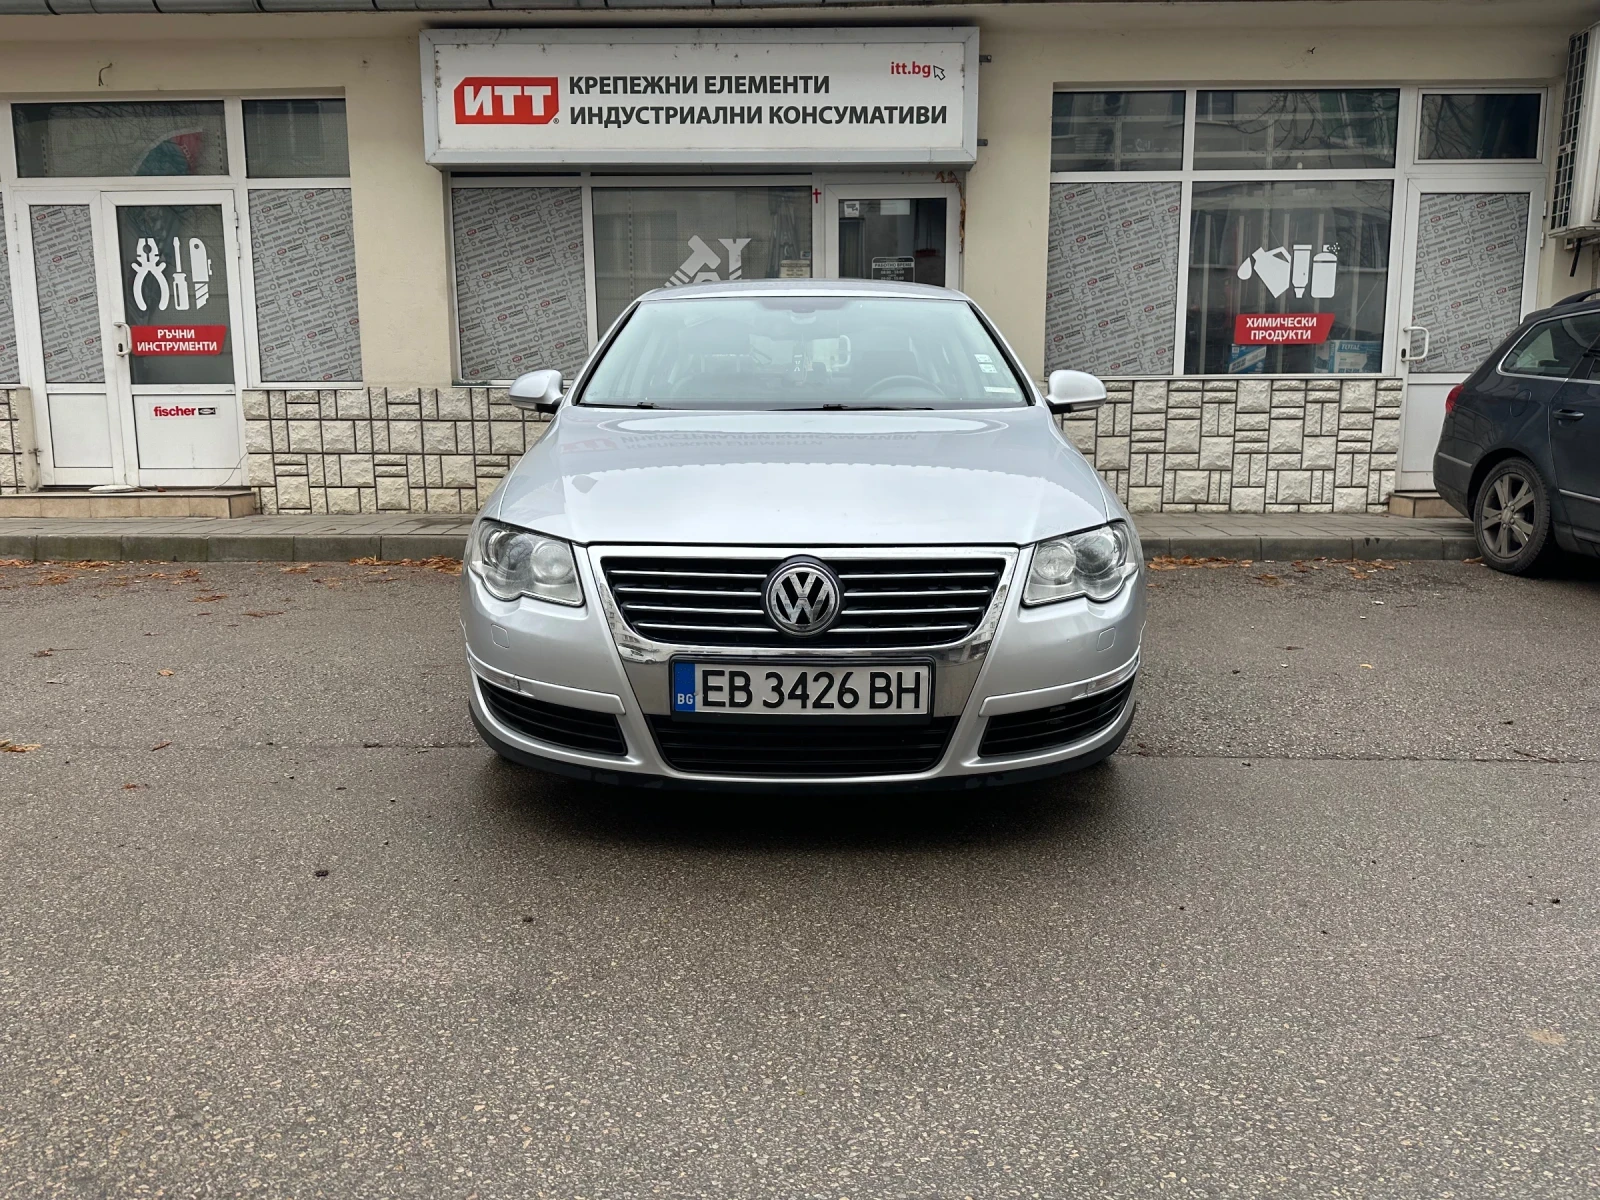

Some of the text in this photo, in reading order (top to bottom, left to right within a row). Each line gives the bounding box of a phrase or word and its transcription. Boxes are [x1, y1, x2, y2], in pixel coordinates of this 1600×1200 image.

[890, 61, 931, 78] itt.bg
[569, 75, 830, 94] КРЕПЕЖНИ ЕЛЕМЕНТИ
[463, 85, 552, 116] ИТТ
[570, 106, 948, 128] ИНДУСТРИАЛНИ КОНСУМАТИВИ
[1246, 317, 1317, 328] ХИМИЧЕСКИ
[157, 329, 195, 339] РЪЧНИ
[1250, 330, 1311, 342] ПРОДУКТИ
[137, 341, 217, 352] ИНСТРУМЕНТИ
[153, 406, 196, 417] fischer
[702, 669, 921, 709] EB 3426 BH
[677, 693, 694, 705] BG
